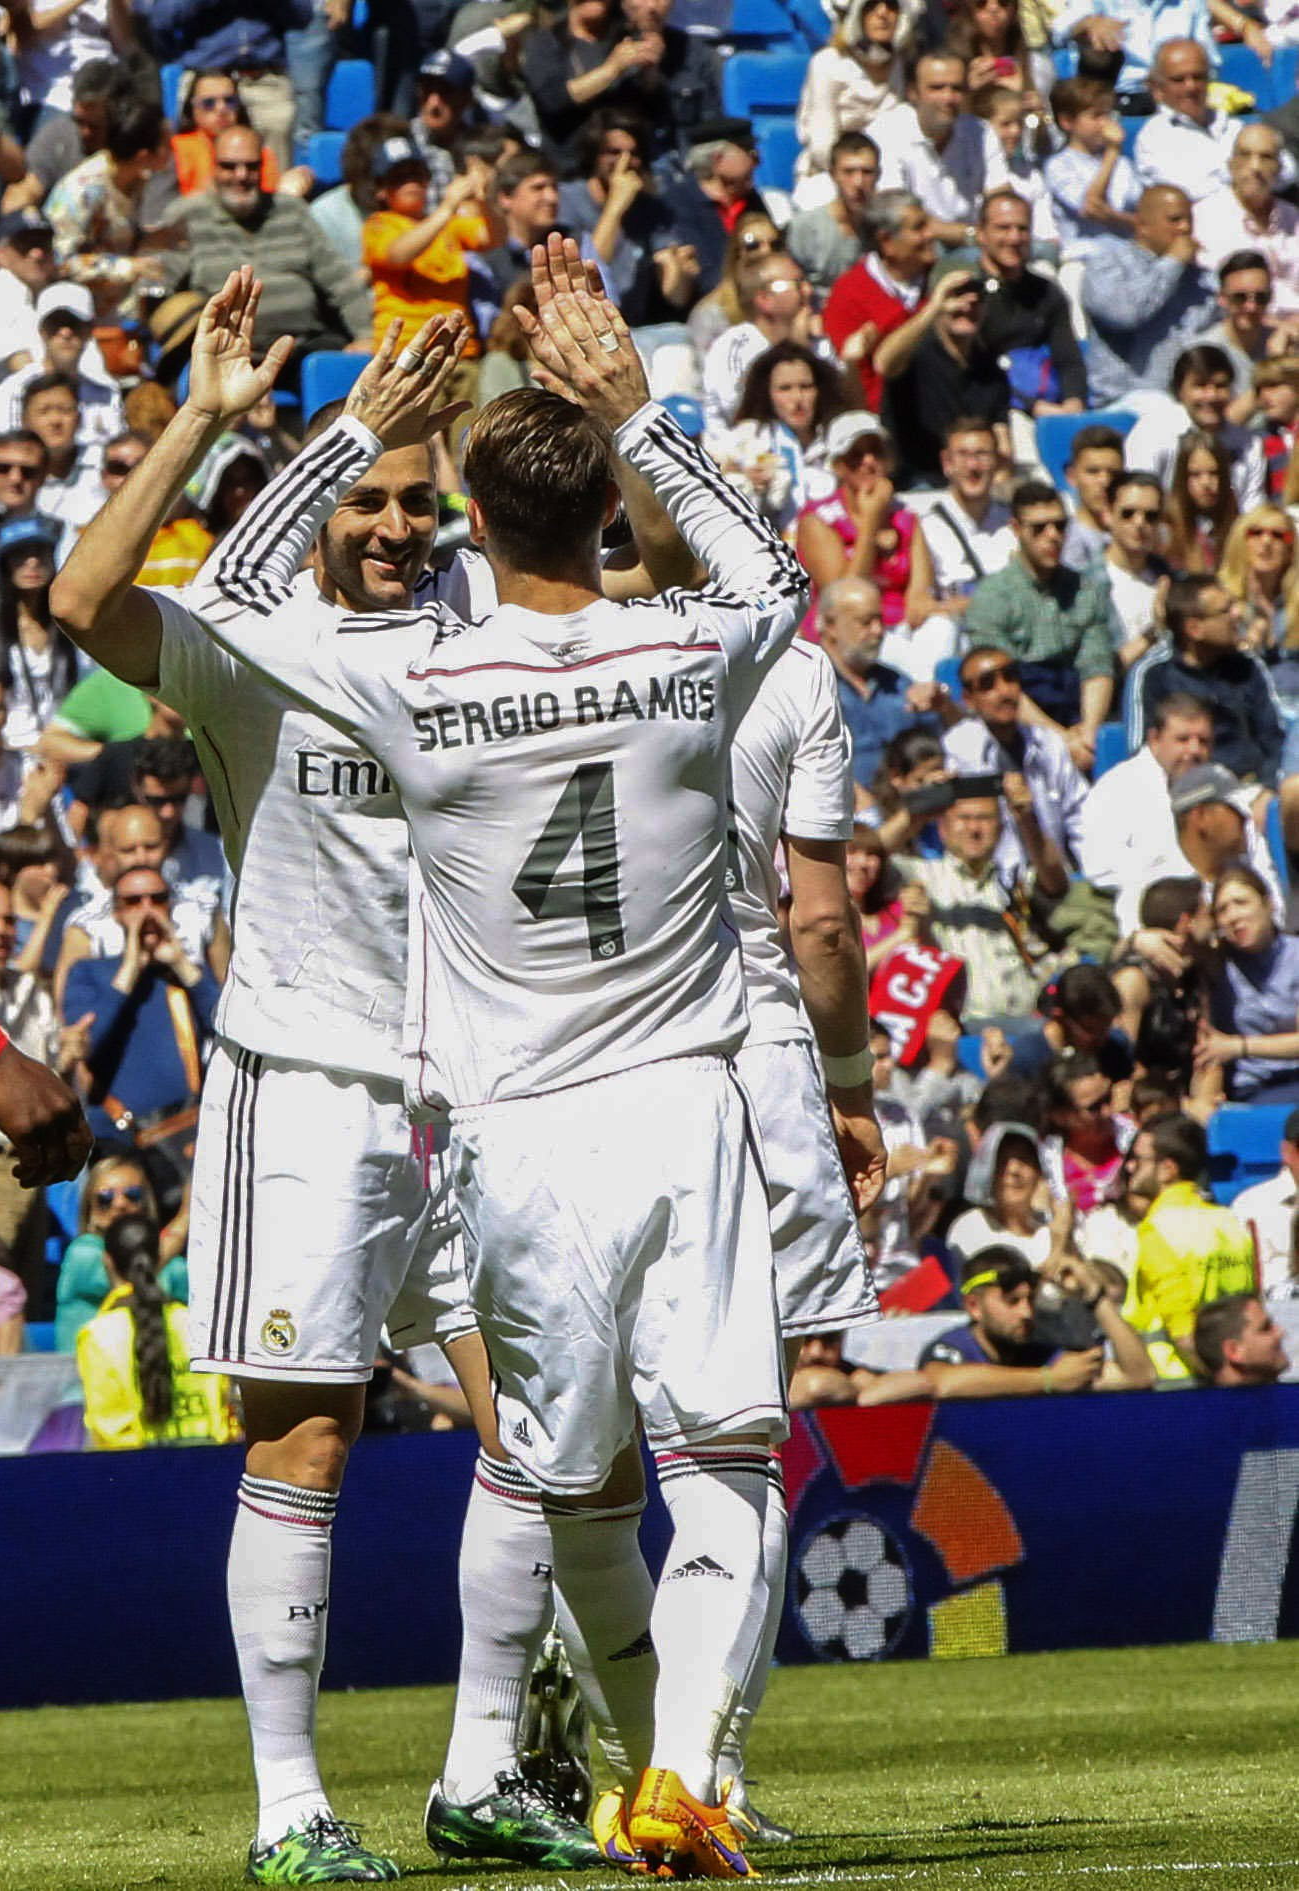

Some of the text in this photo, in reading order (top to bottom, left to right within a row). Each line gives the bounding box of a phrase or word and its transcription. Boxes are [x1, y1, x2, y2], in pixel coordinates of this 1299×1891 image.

[412, 676, 715, 752] SERGIO RAMOS
[510, 760, 626, 962] 4
